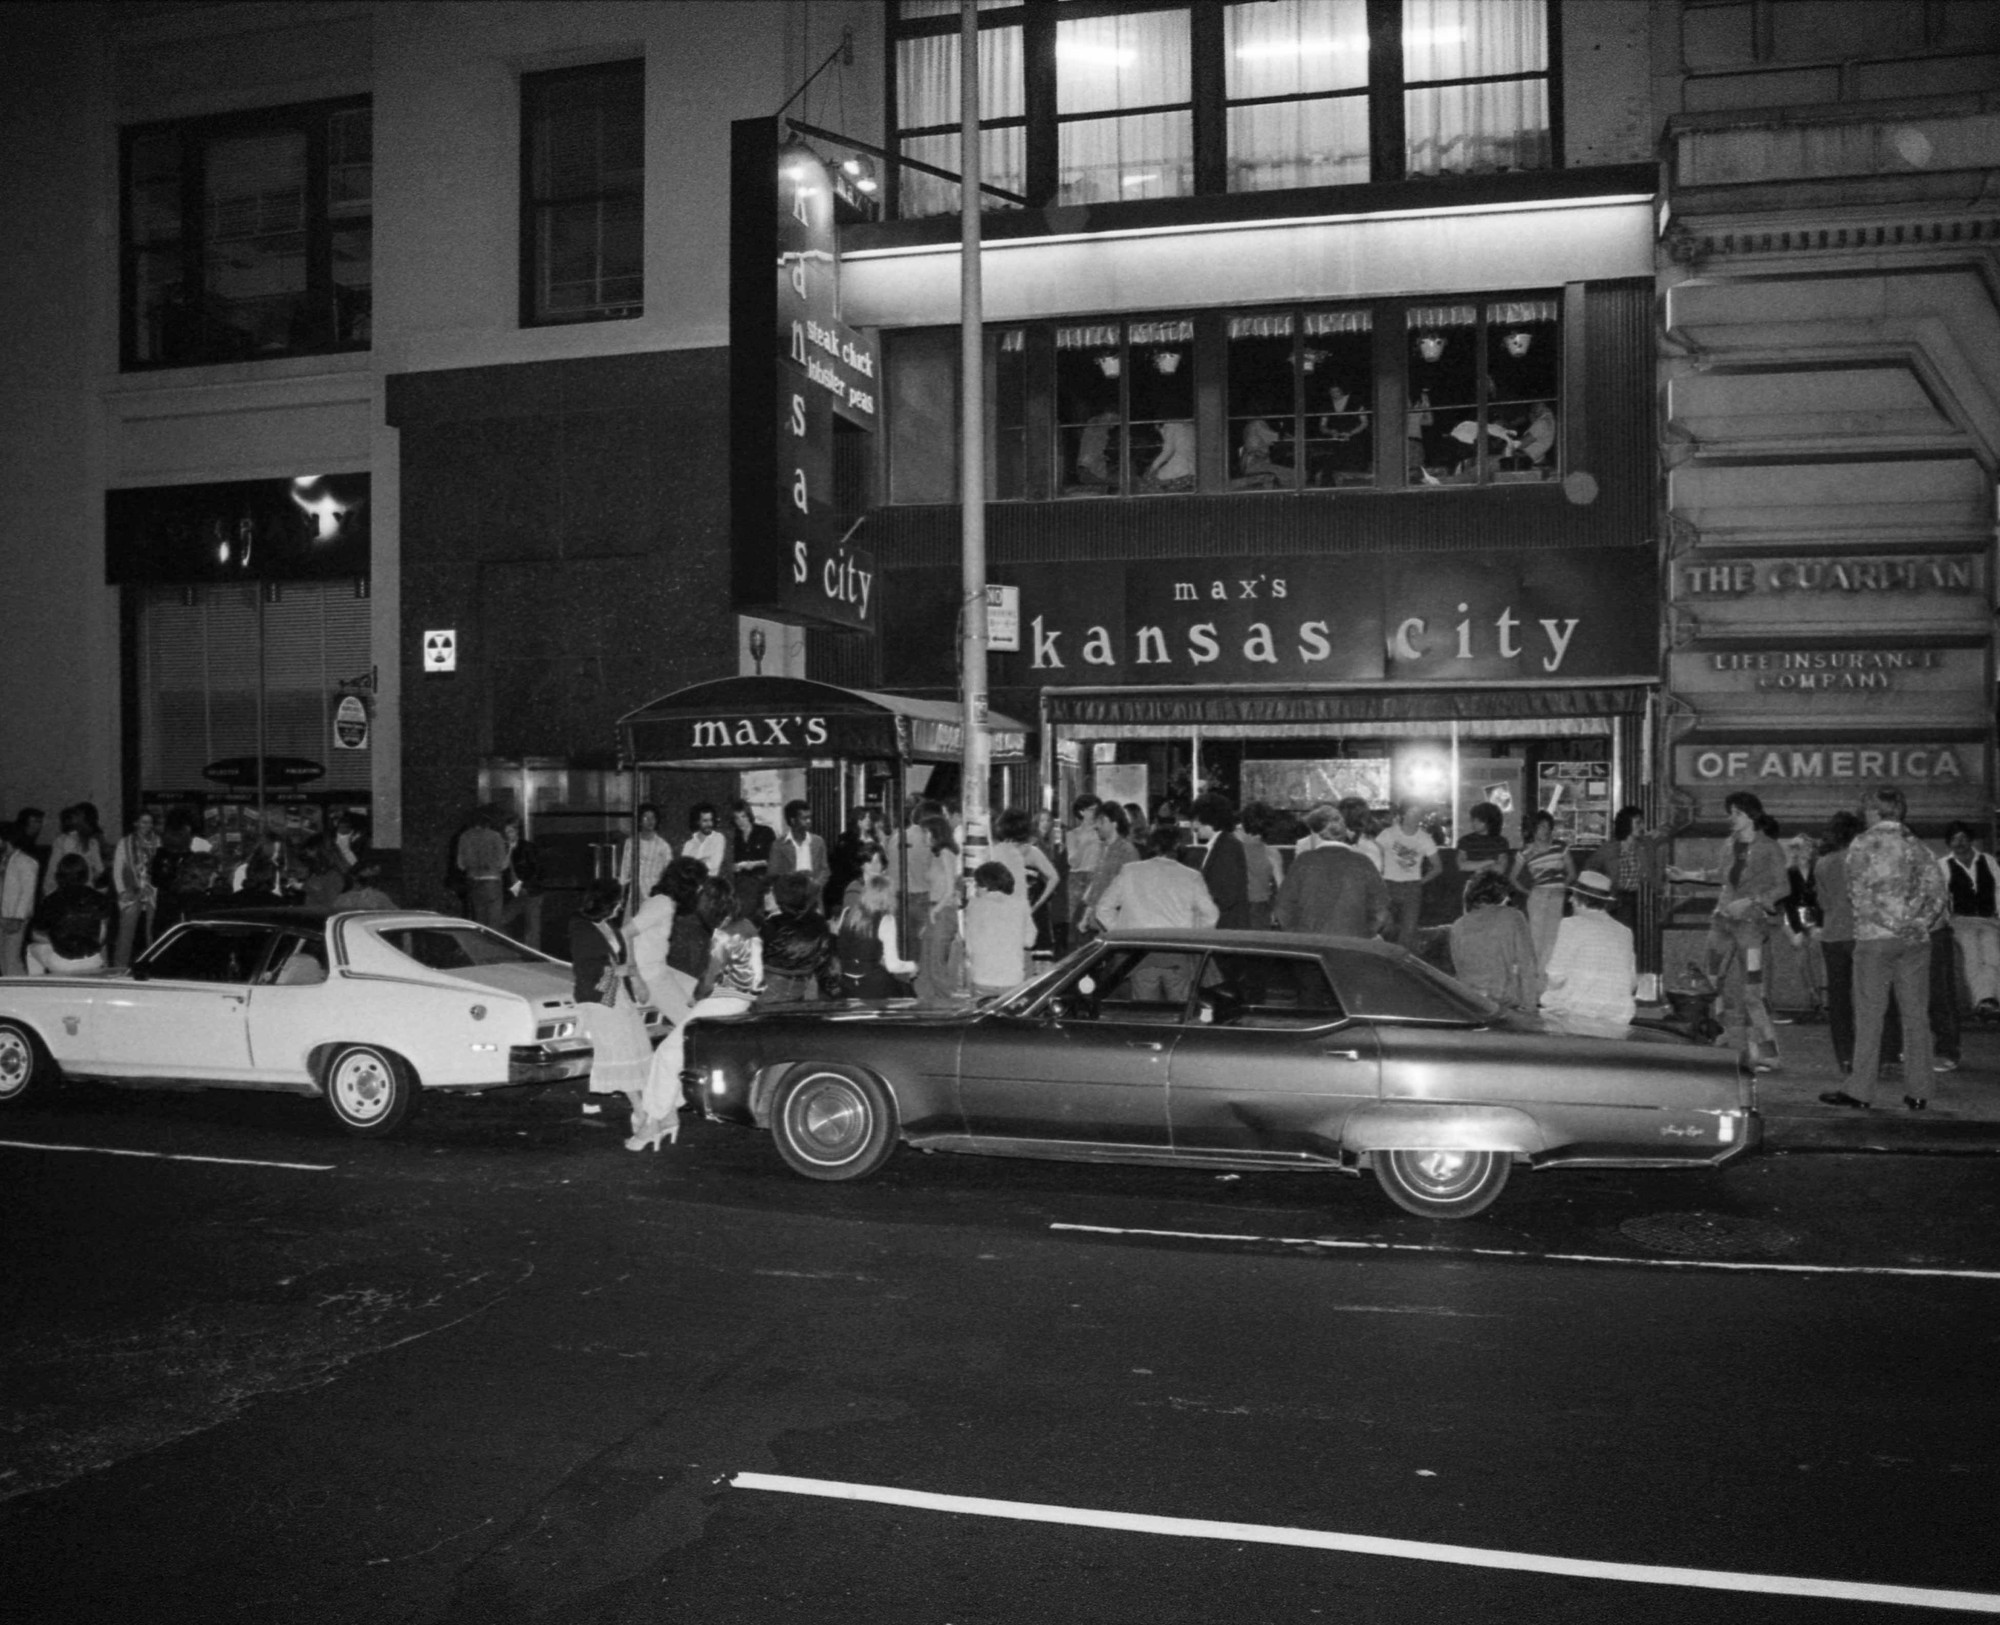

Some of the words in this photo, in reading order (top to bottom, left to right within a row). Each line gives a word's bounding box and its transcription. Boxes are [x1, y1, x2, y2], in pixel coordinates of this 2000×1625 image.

[824, 547, 871, 620] city
[1174, 574, 1287, 601] max's
[1687, 564, 1748, 592] THE
[1030, 615, 1331, 669] kansas
[1397, 602, 1579, 671] city
[1715, 654, 1769, 670] LIFE
[691, 715, 828, 748] max's
[1697, 752, 1749, 778] OF
[1760, 752, 1960, 778] AMERICA
